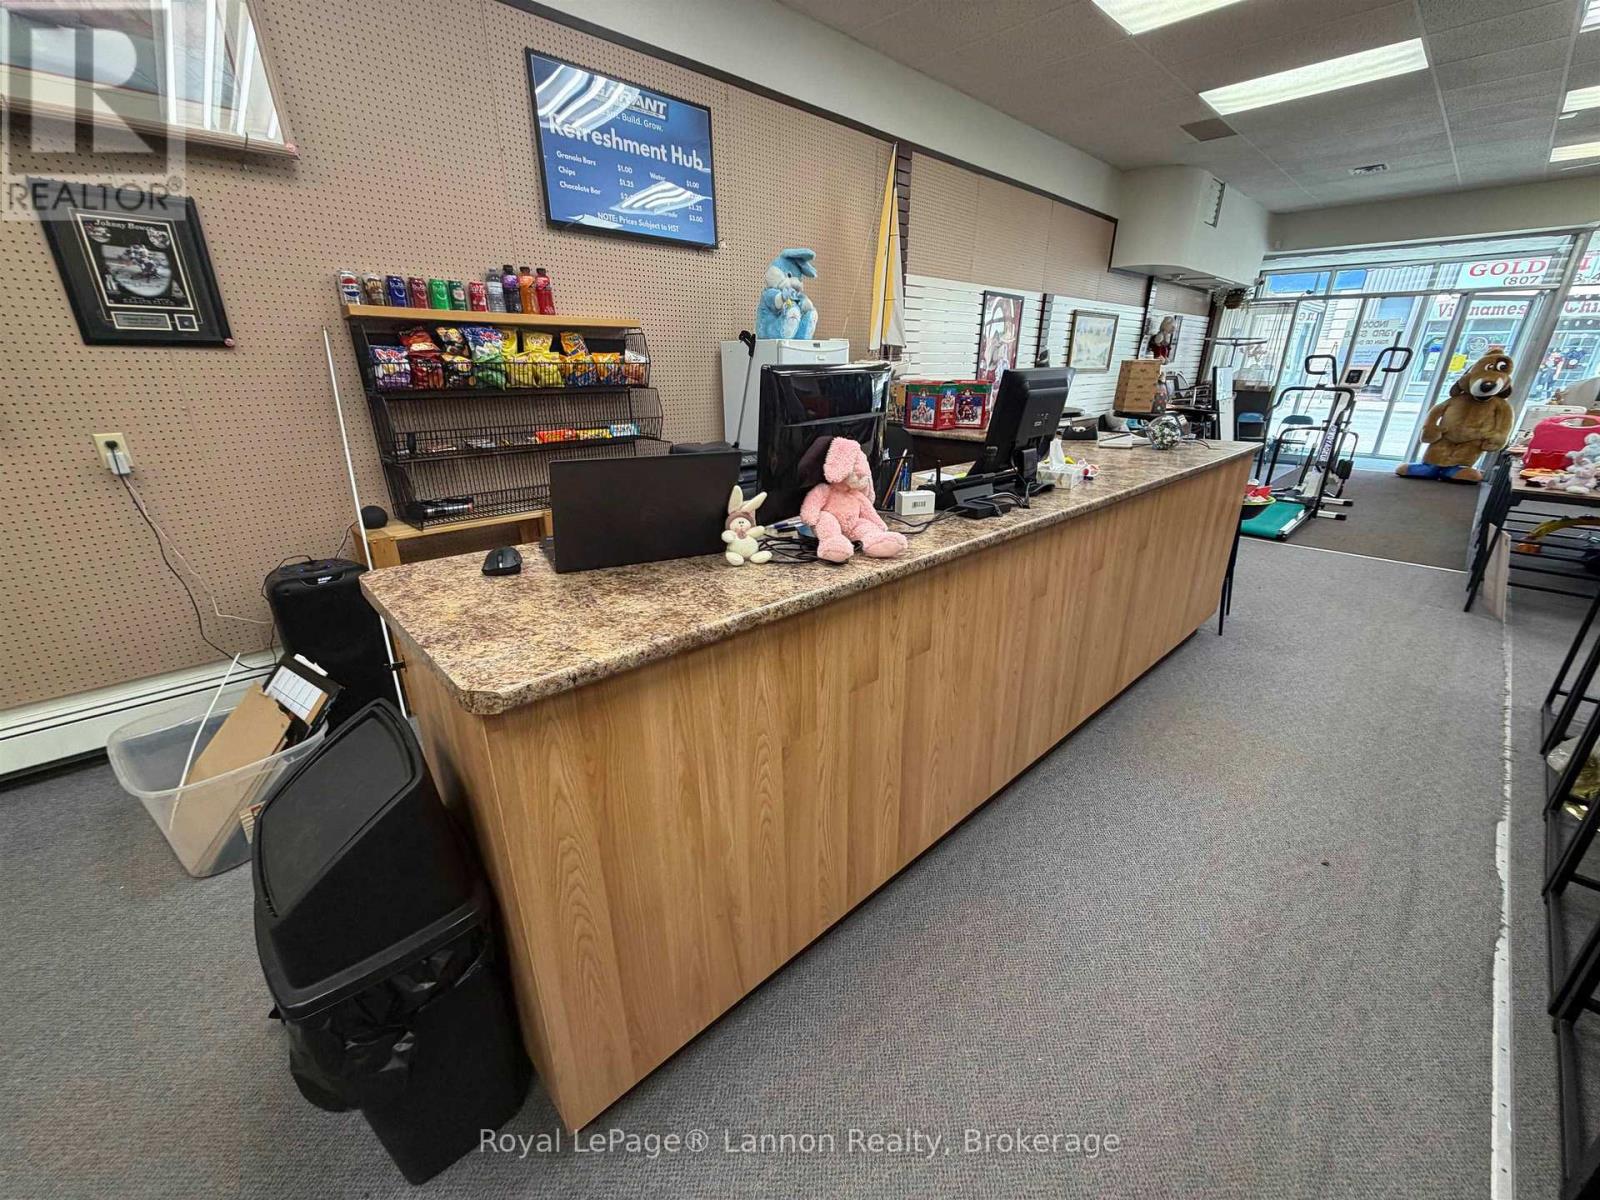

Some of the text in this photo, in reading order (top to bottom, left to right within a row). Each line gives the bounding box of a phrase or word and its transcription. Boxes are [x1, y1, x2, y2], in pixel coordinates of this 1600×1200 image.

[549, 112, 704, 170] Refreshment Hub
[556, 150, 597, 166] Granola Bars
[558, 165, 576, 176] Chips
[649, 171, 666, 181] Water
[559, 180, 590, 194] Chocolate
[597, 211, 619, 222] NOTE:
[619, 215, 638, 226] Prices
[639, 219, 660, 230] Subject
[660, 223, 668, 231] to
[1469, 258, 1547, 277] GOLD
